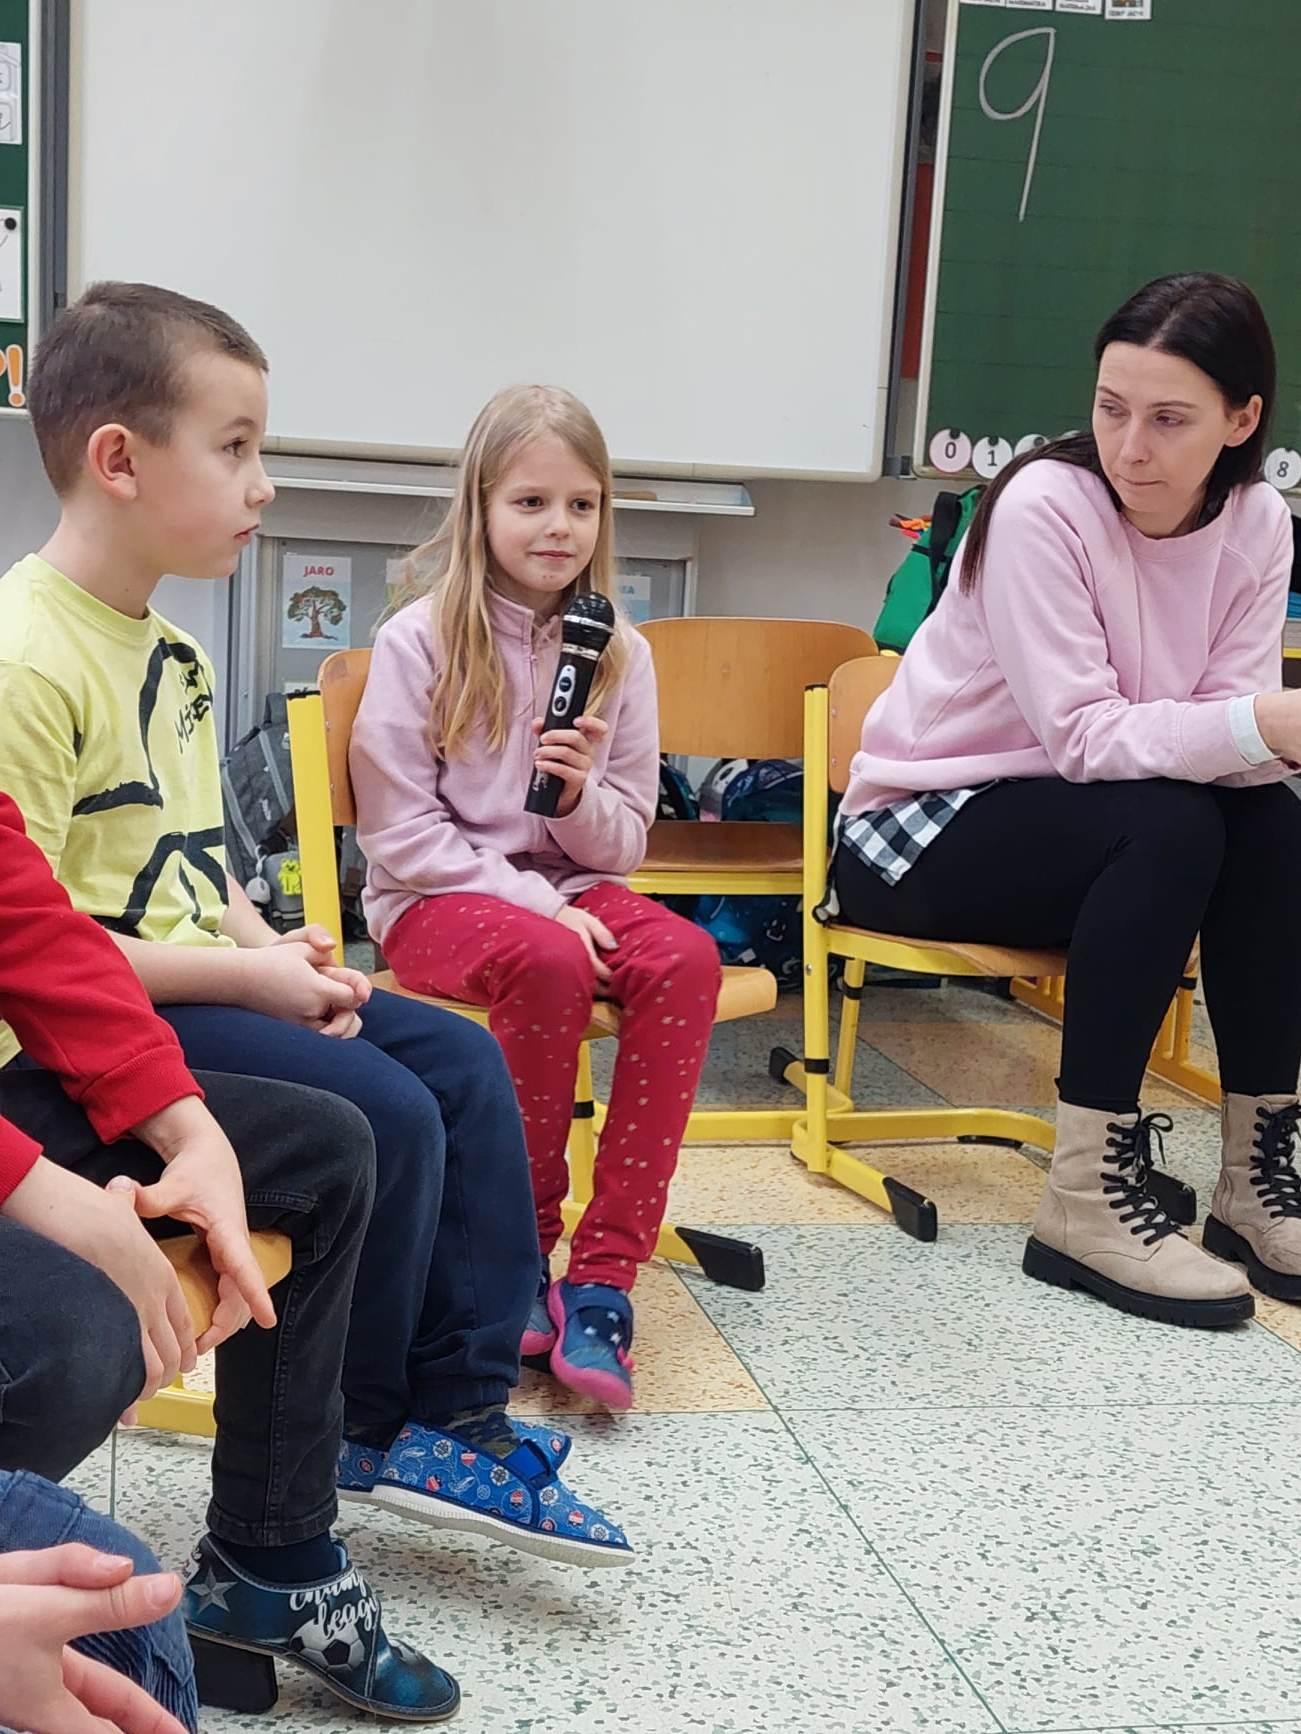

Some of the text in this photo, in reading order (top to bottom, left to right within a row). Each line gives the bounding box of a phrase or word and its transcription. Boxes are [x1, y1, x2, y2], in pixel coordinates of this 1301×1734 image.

[978, 26, 1057, 223] 9
[944, 441, 1290, 479] 0 1 8
[303, 565, 335, 578] JARO
